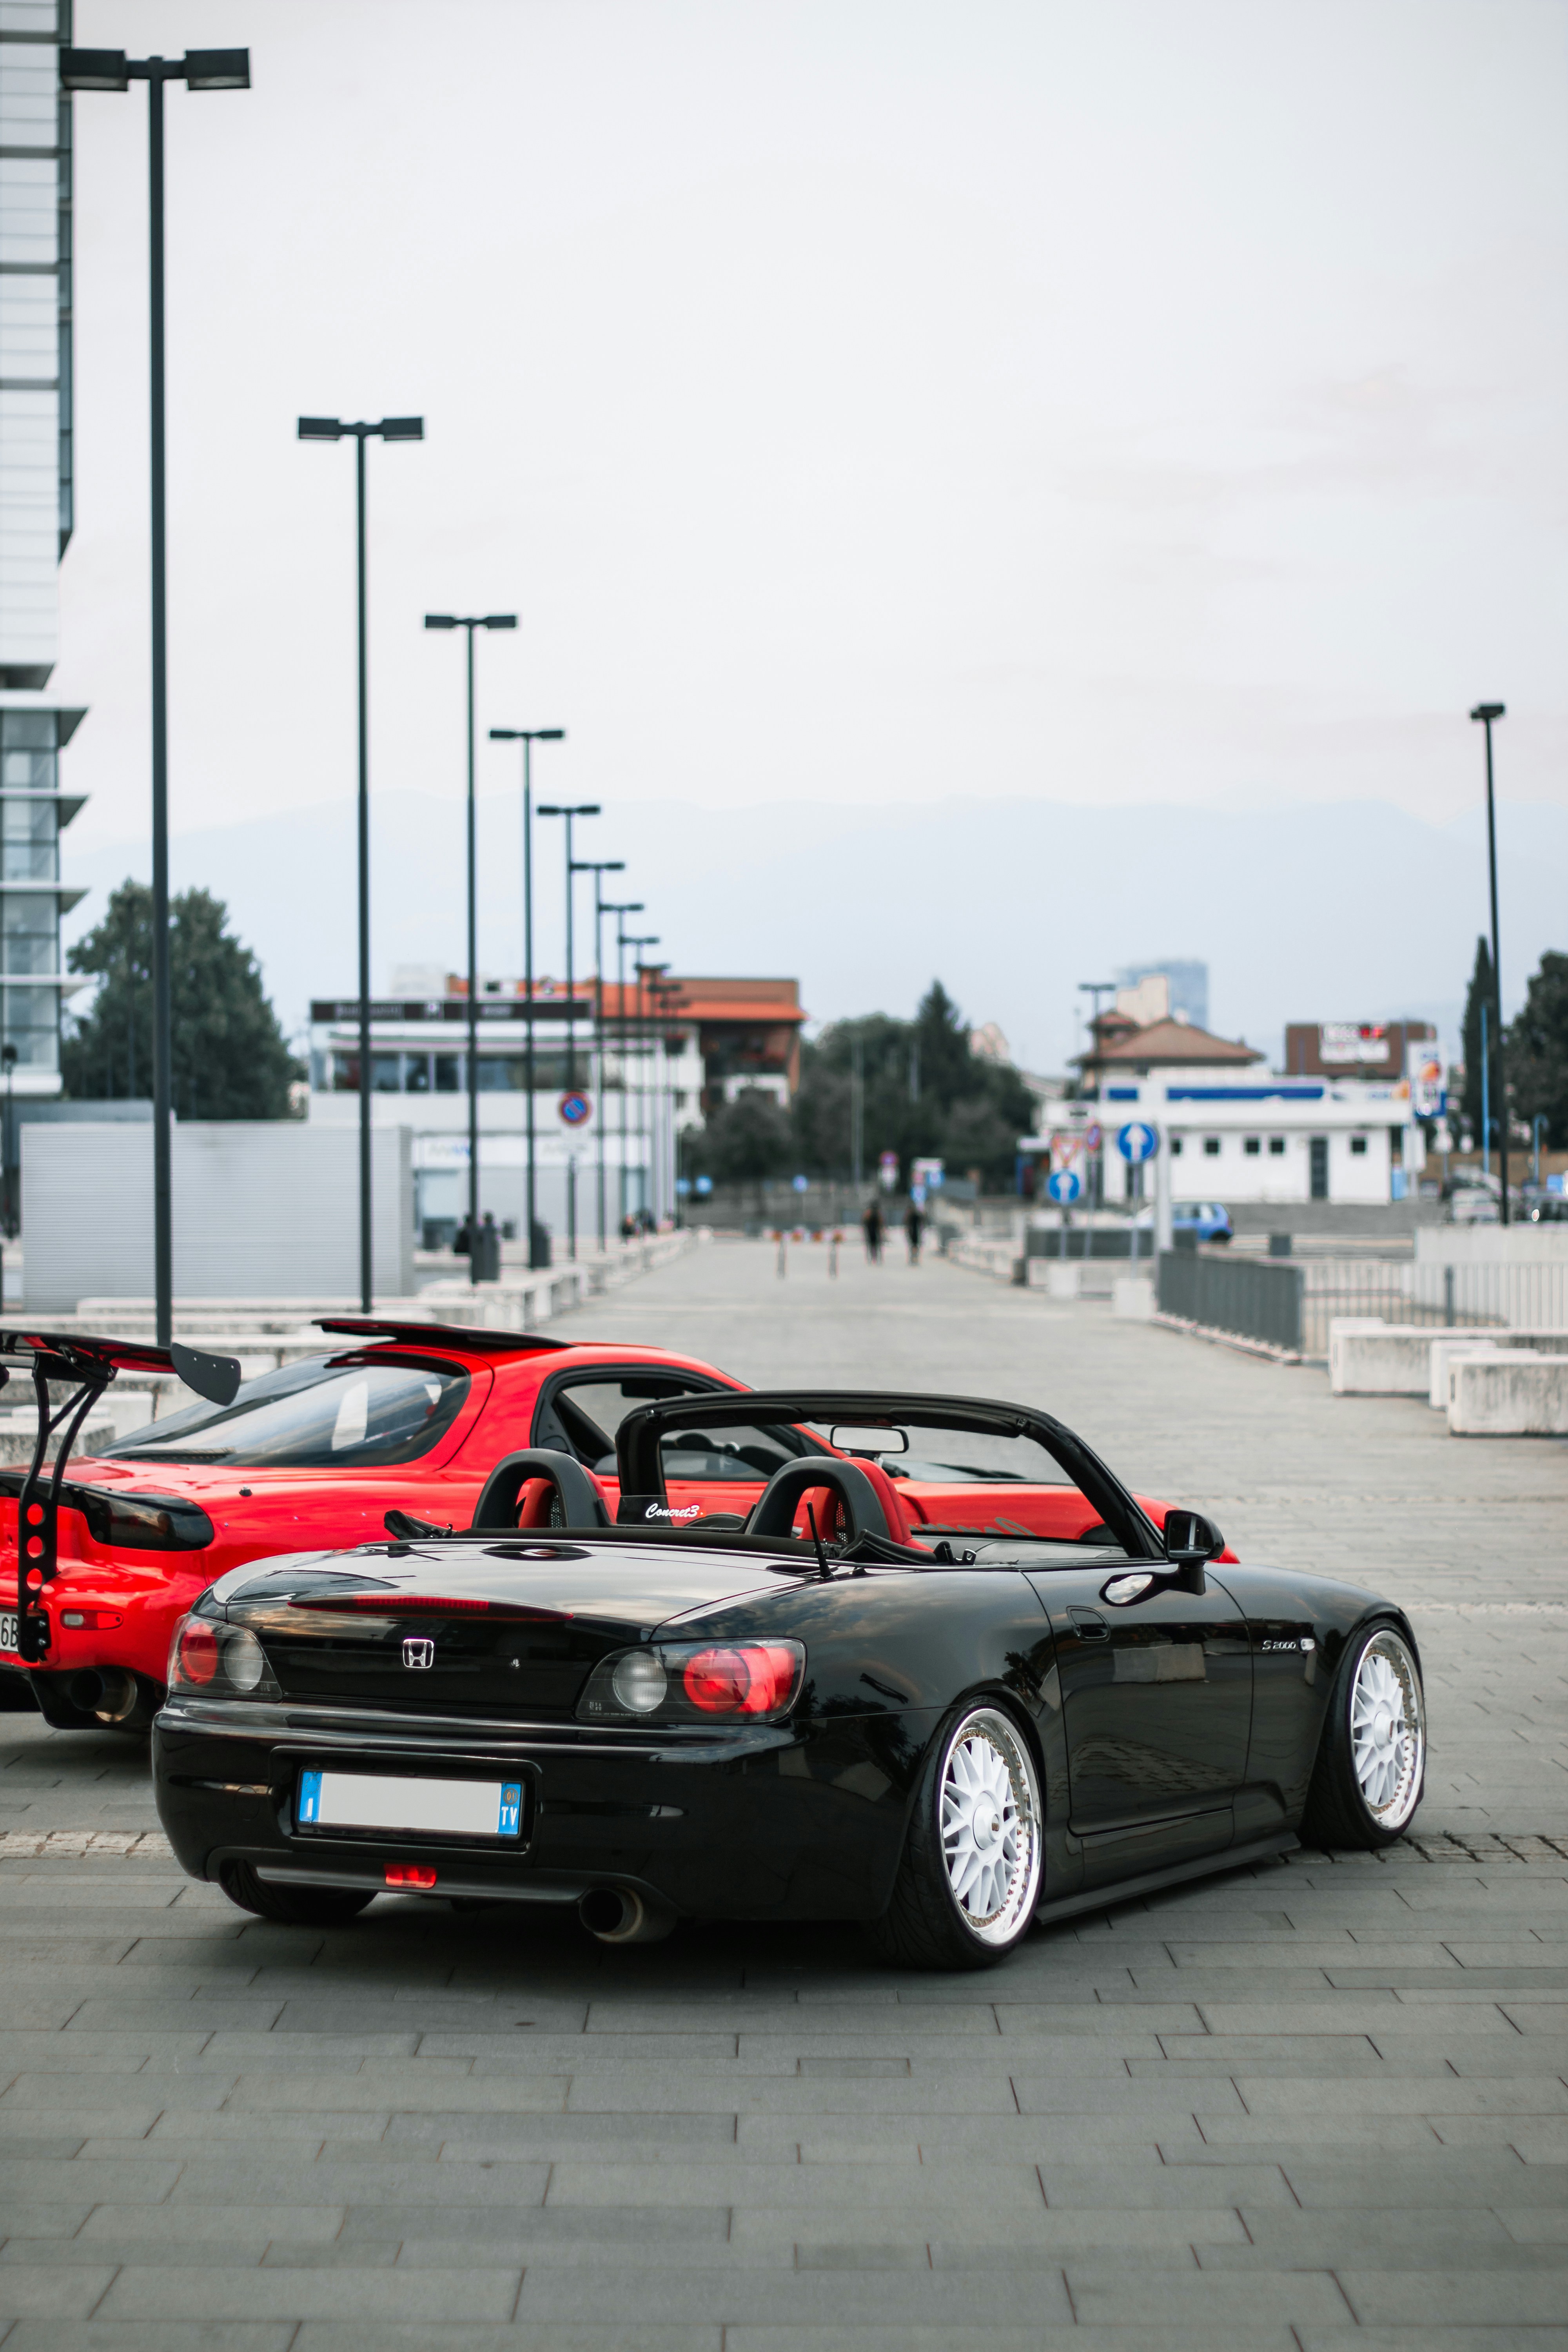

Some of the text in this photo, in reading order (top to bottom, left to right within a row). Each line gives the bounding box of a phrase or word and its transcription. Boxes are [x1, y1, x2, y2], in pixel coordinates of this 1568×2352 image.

[646, 1503, 700, 1518] Concret3
[1261, 1640, 1296, 1650] S2000
[307, 1798, 313, 1817] I
[501, 1806, 517, 1826] TV
